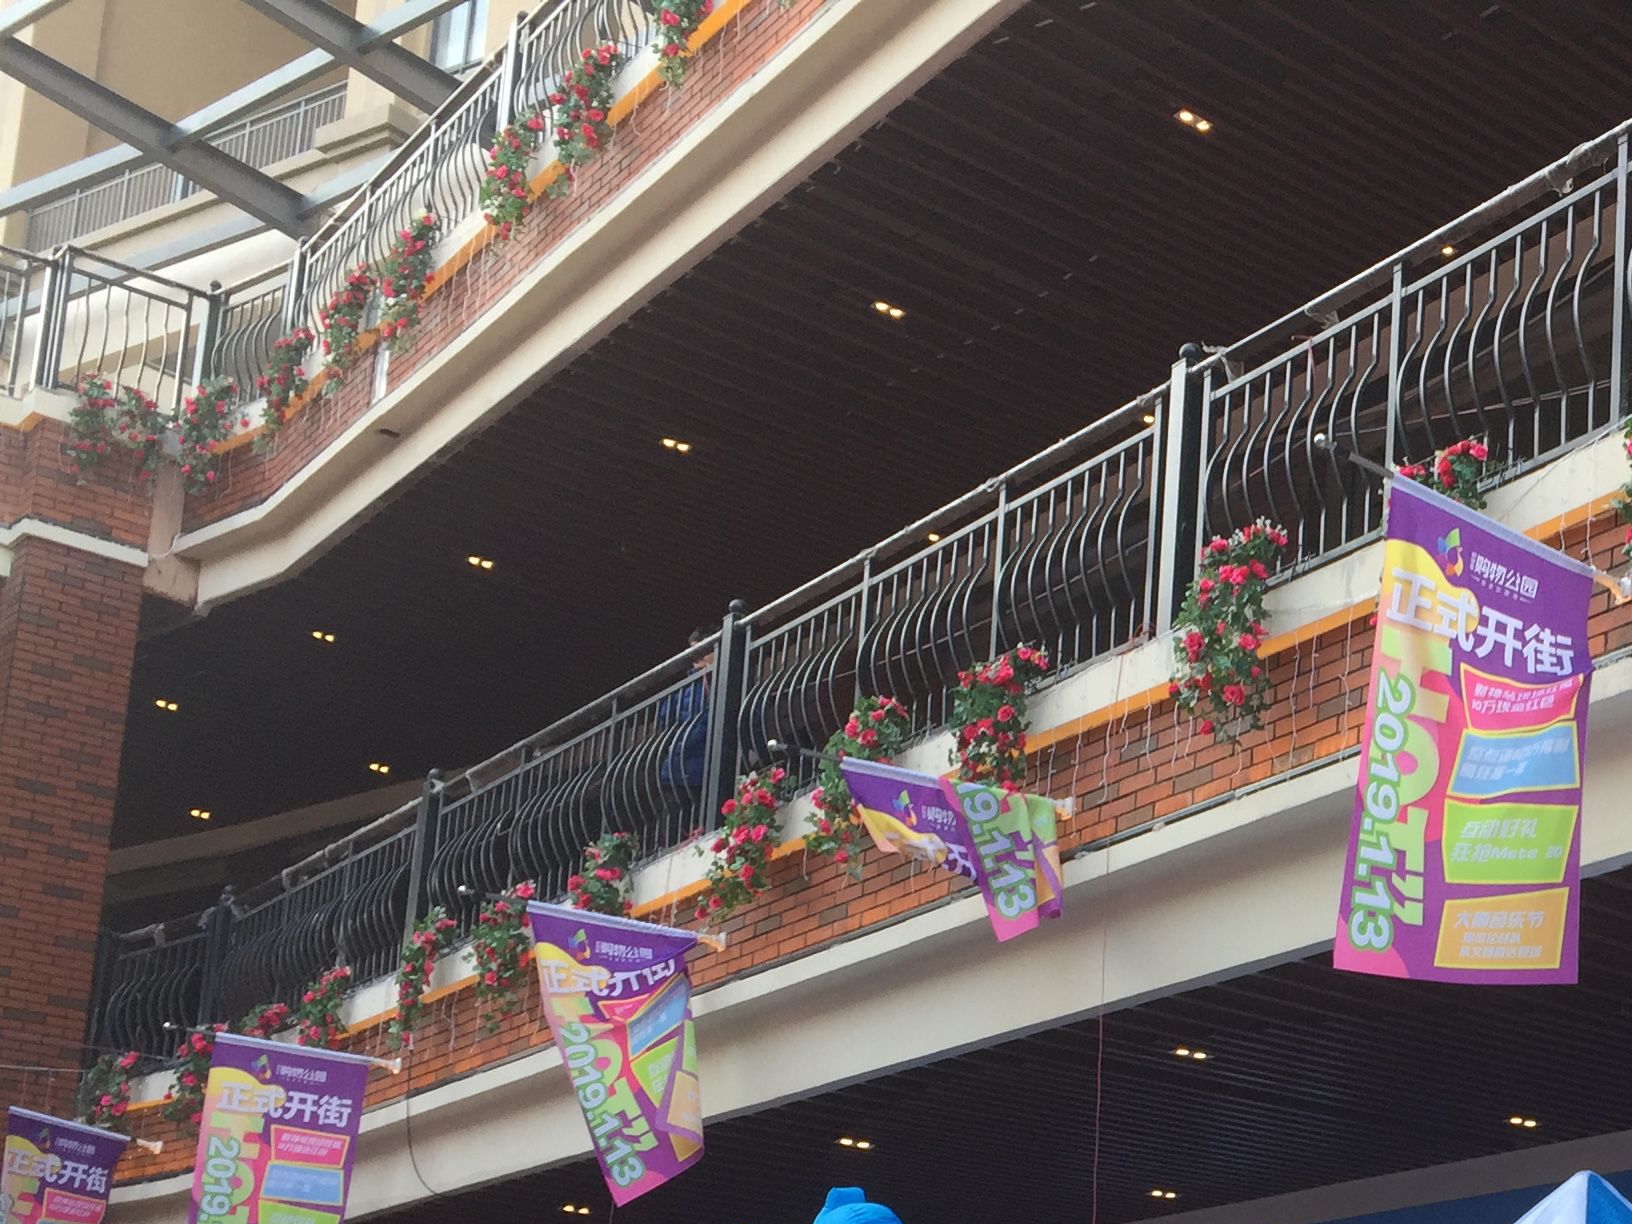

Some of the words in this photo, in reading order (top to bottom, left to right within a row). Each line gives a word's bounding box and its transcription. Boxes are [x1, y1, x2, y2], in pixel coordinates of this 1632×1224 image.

[1387, 568, 1575, 677] 正式开街
[1350, 670, 1413, 950] 2019.1.13
[216, 1080, 353, 1128] 正式开街
[559, 1022, 645, 1188] 2019.1.13
